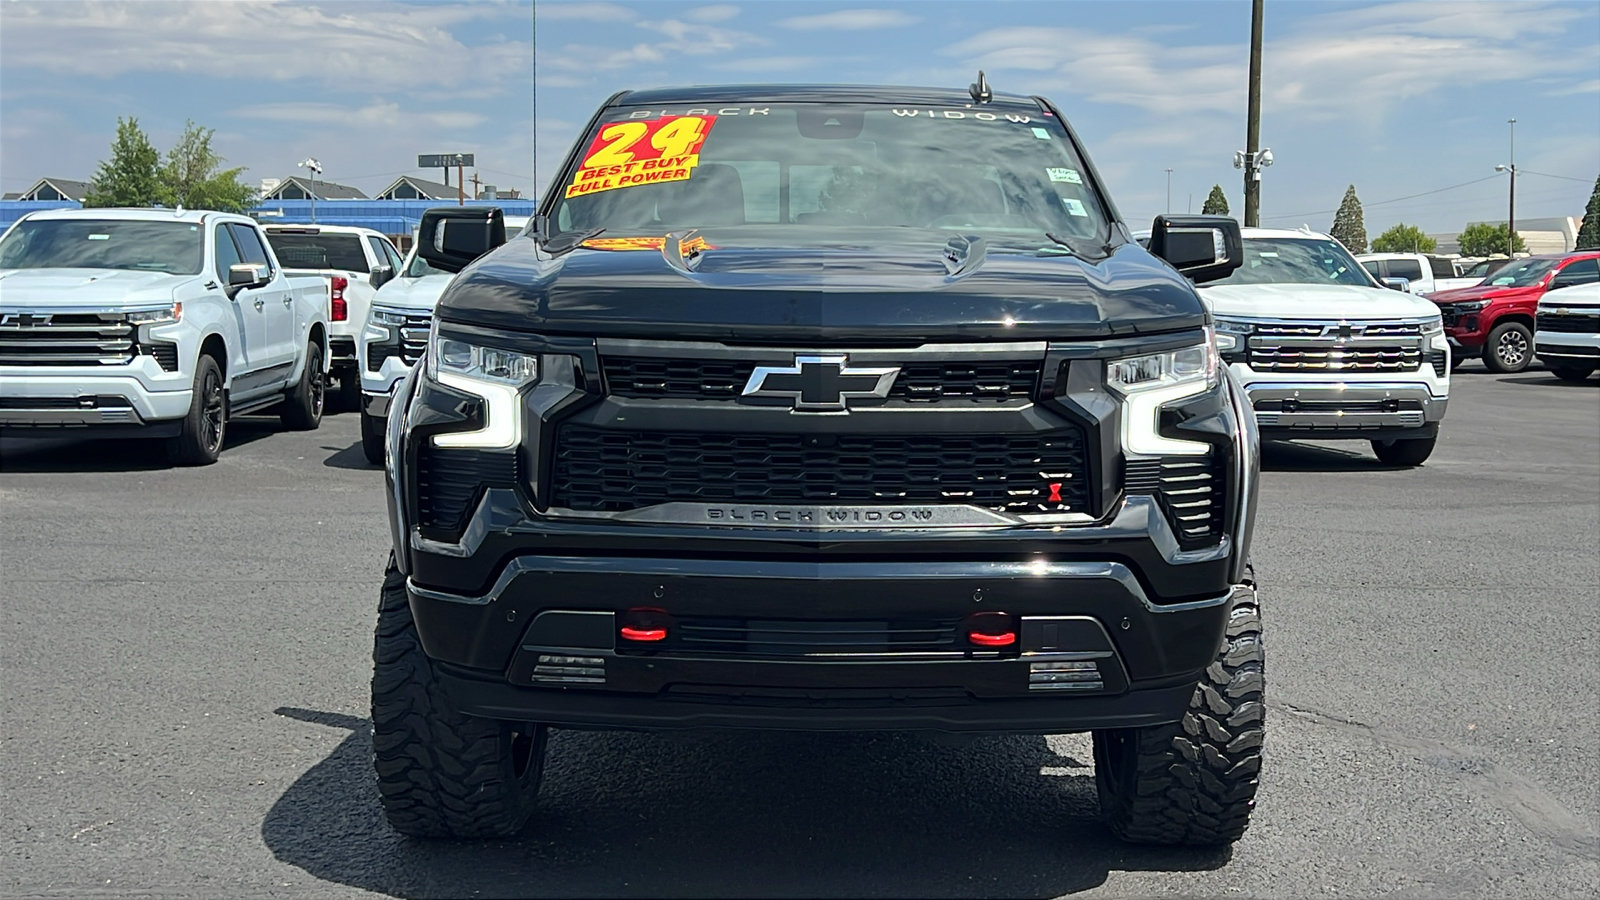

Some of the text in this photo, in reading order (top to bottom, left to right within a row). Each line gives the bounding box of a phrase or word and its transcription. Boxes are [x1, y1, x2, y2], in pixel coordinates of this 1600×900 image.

[630, 107, 1030, 124] BLACK WIDOW
[584, 116, 706, 169] 24
[581, 156, 693, 181] BEST BUY
[568, 169, 687, 196] FULL POWER
[707, 508, 932, 521] BLACK WIDOW
